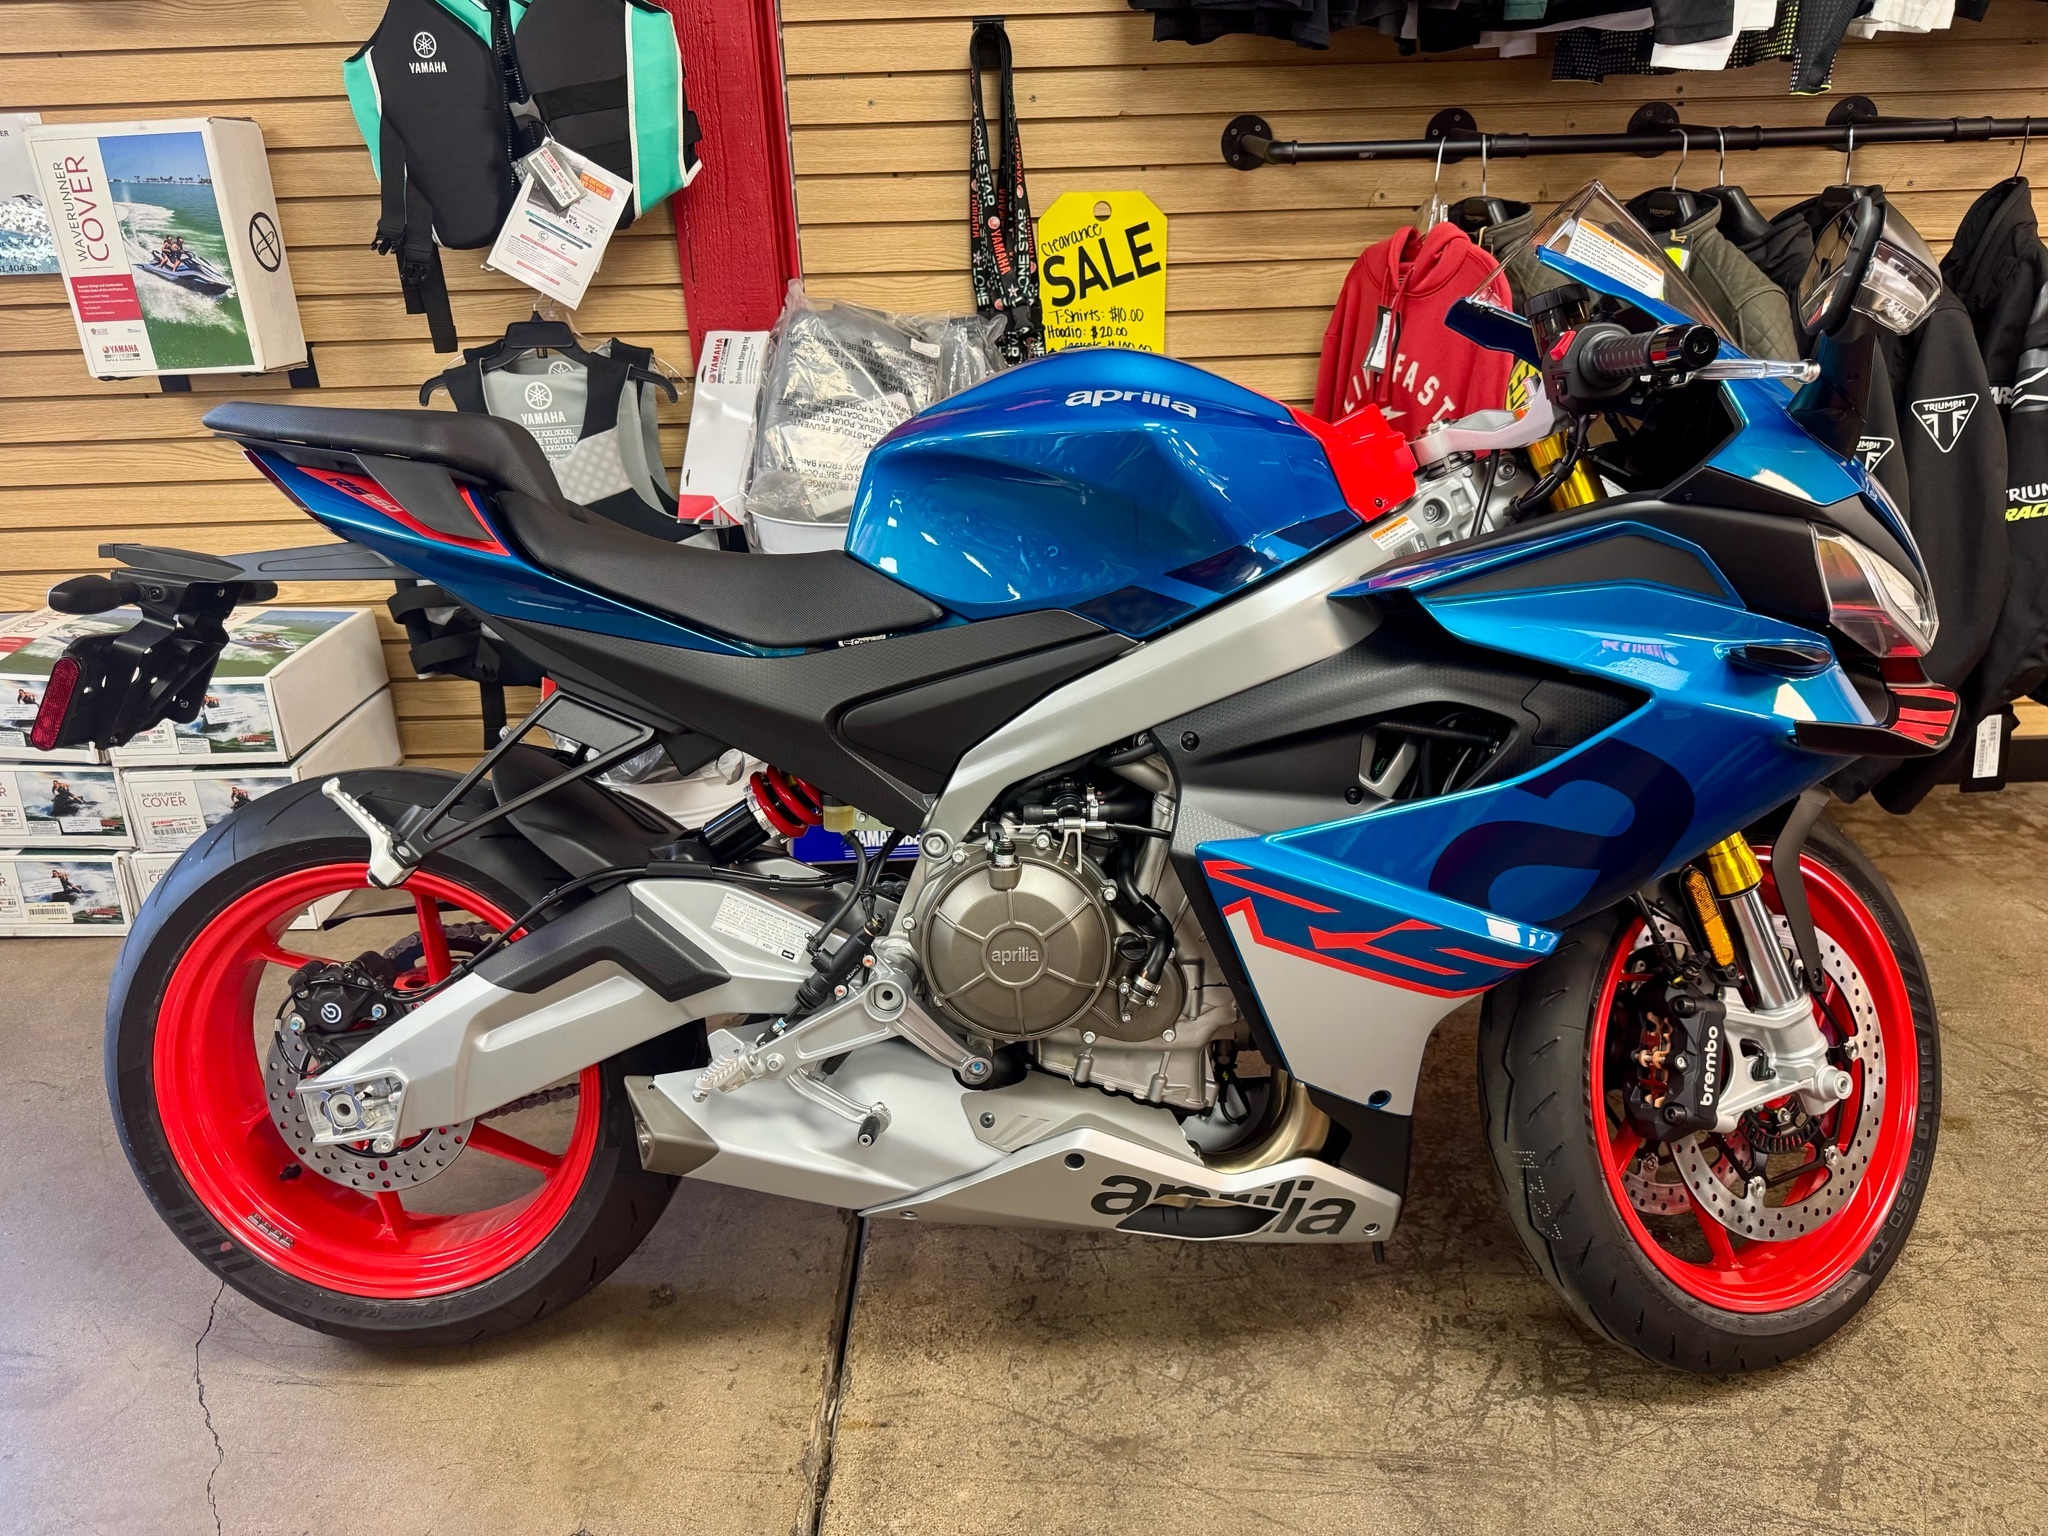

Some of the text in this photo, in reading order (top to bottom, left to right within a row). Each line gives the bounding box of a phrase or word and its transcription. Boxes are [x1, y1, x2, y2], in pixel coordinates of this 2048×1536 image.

[409, 61, 447, 74] YAMAHA
[974, 117, 986, 161] LONE
[53, 161, 88, 262] WAVERUNNER
[65, 155, 110, 262] COVER
[990, 229, 1011, 275] YAMAHA
[1041, 223, 1102, 257] Clearance
[1043, 221, 1162, 307] SALE
[1049, 306, 1144, 325] T-Shirts: $10.00
[110, 344, 139, 353] YAMAHA
[710, 338, 724, 373] YAMAHA
[1392, 353, 1457, 422] FAST
[521, 411, 567, 425] YAMAHA
[788, 409, 798, 418] LE
[1065, 390, 1197, 418] aprilia
[1923, 399, 1966, 412] TRIUMPH
[792, 419, 878, 442] PLASTIQUE PEUVENT
[832, 417, 855, 428] POUR
[842, 473, 853, 481] OF
[142, 796, 188, 808] COVER
[991, 946, 1040, 966] aprilia
[1700, 1025, 1719, 1107] brembo
[1917, 1038, 1934, 1140] DIABLO
[1889, 1148, 1925, 1229] ROSSO
[1090, 1174, 1357, 1236] ailia
